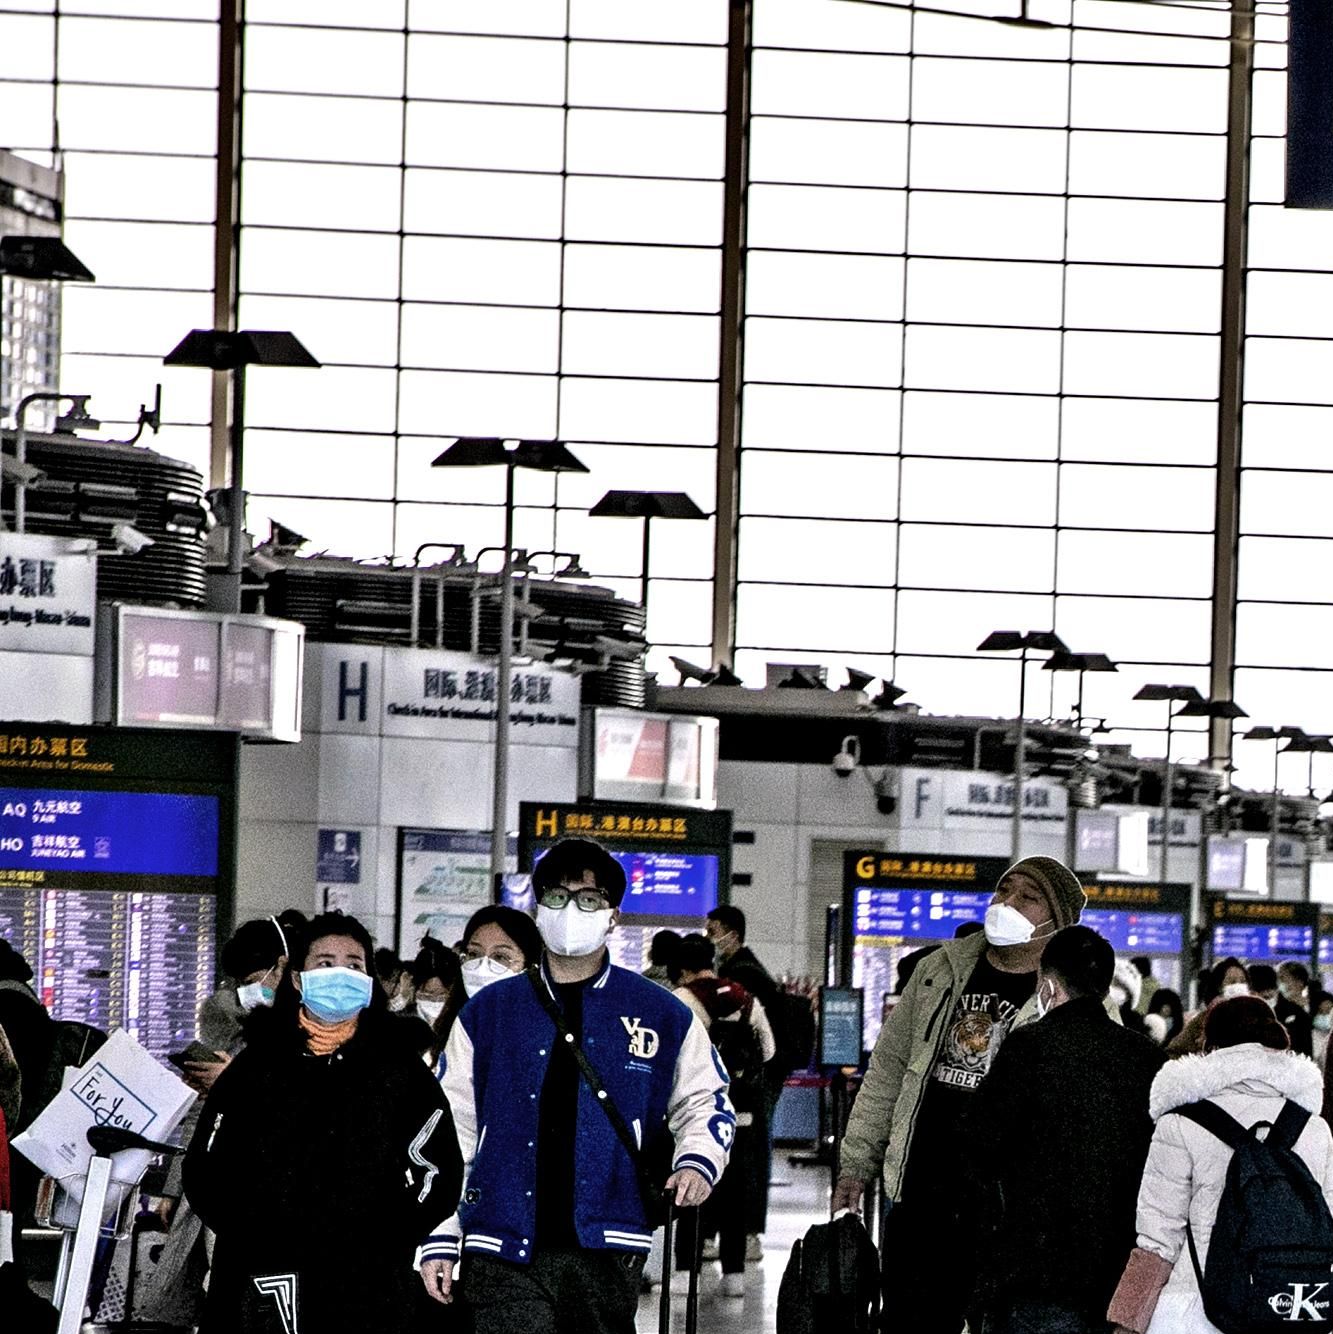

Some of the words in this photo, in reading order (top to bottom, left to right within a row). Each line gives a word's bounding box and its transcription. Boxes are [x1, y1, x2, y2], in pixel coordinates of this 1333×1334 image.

[338, 660, 368, 722] H
[3, 803, 27, 818] AQ
[535, 809, 558, 838] H
[856, 856, 876, 879] G
[79, 1076, 107, 1106] For
